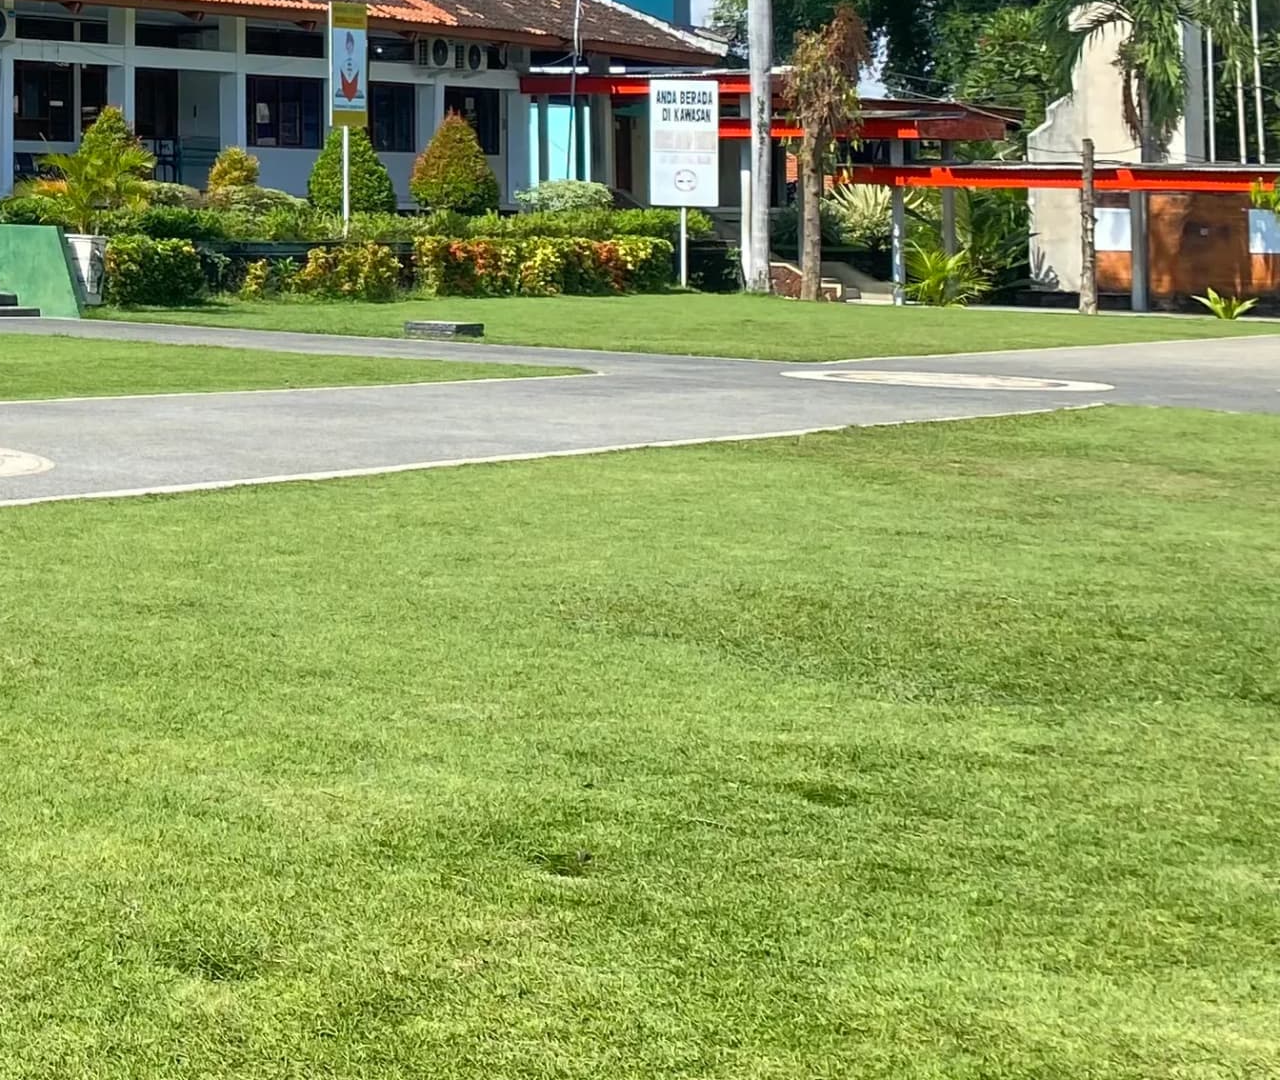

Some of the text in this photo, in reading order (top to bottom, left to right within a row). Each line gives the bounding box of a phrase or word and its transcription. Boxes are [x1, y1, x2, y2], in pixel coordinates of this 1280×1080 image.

[656, 90, 713, 105] ANDA BERADA
[662, 108, 711, 122] DI KAWASAN
